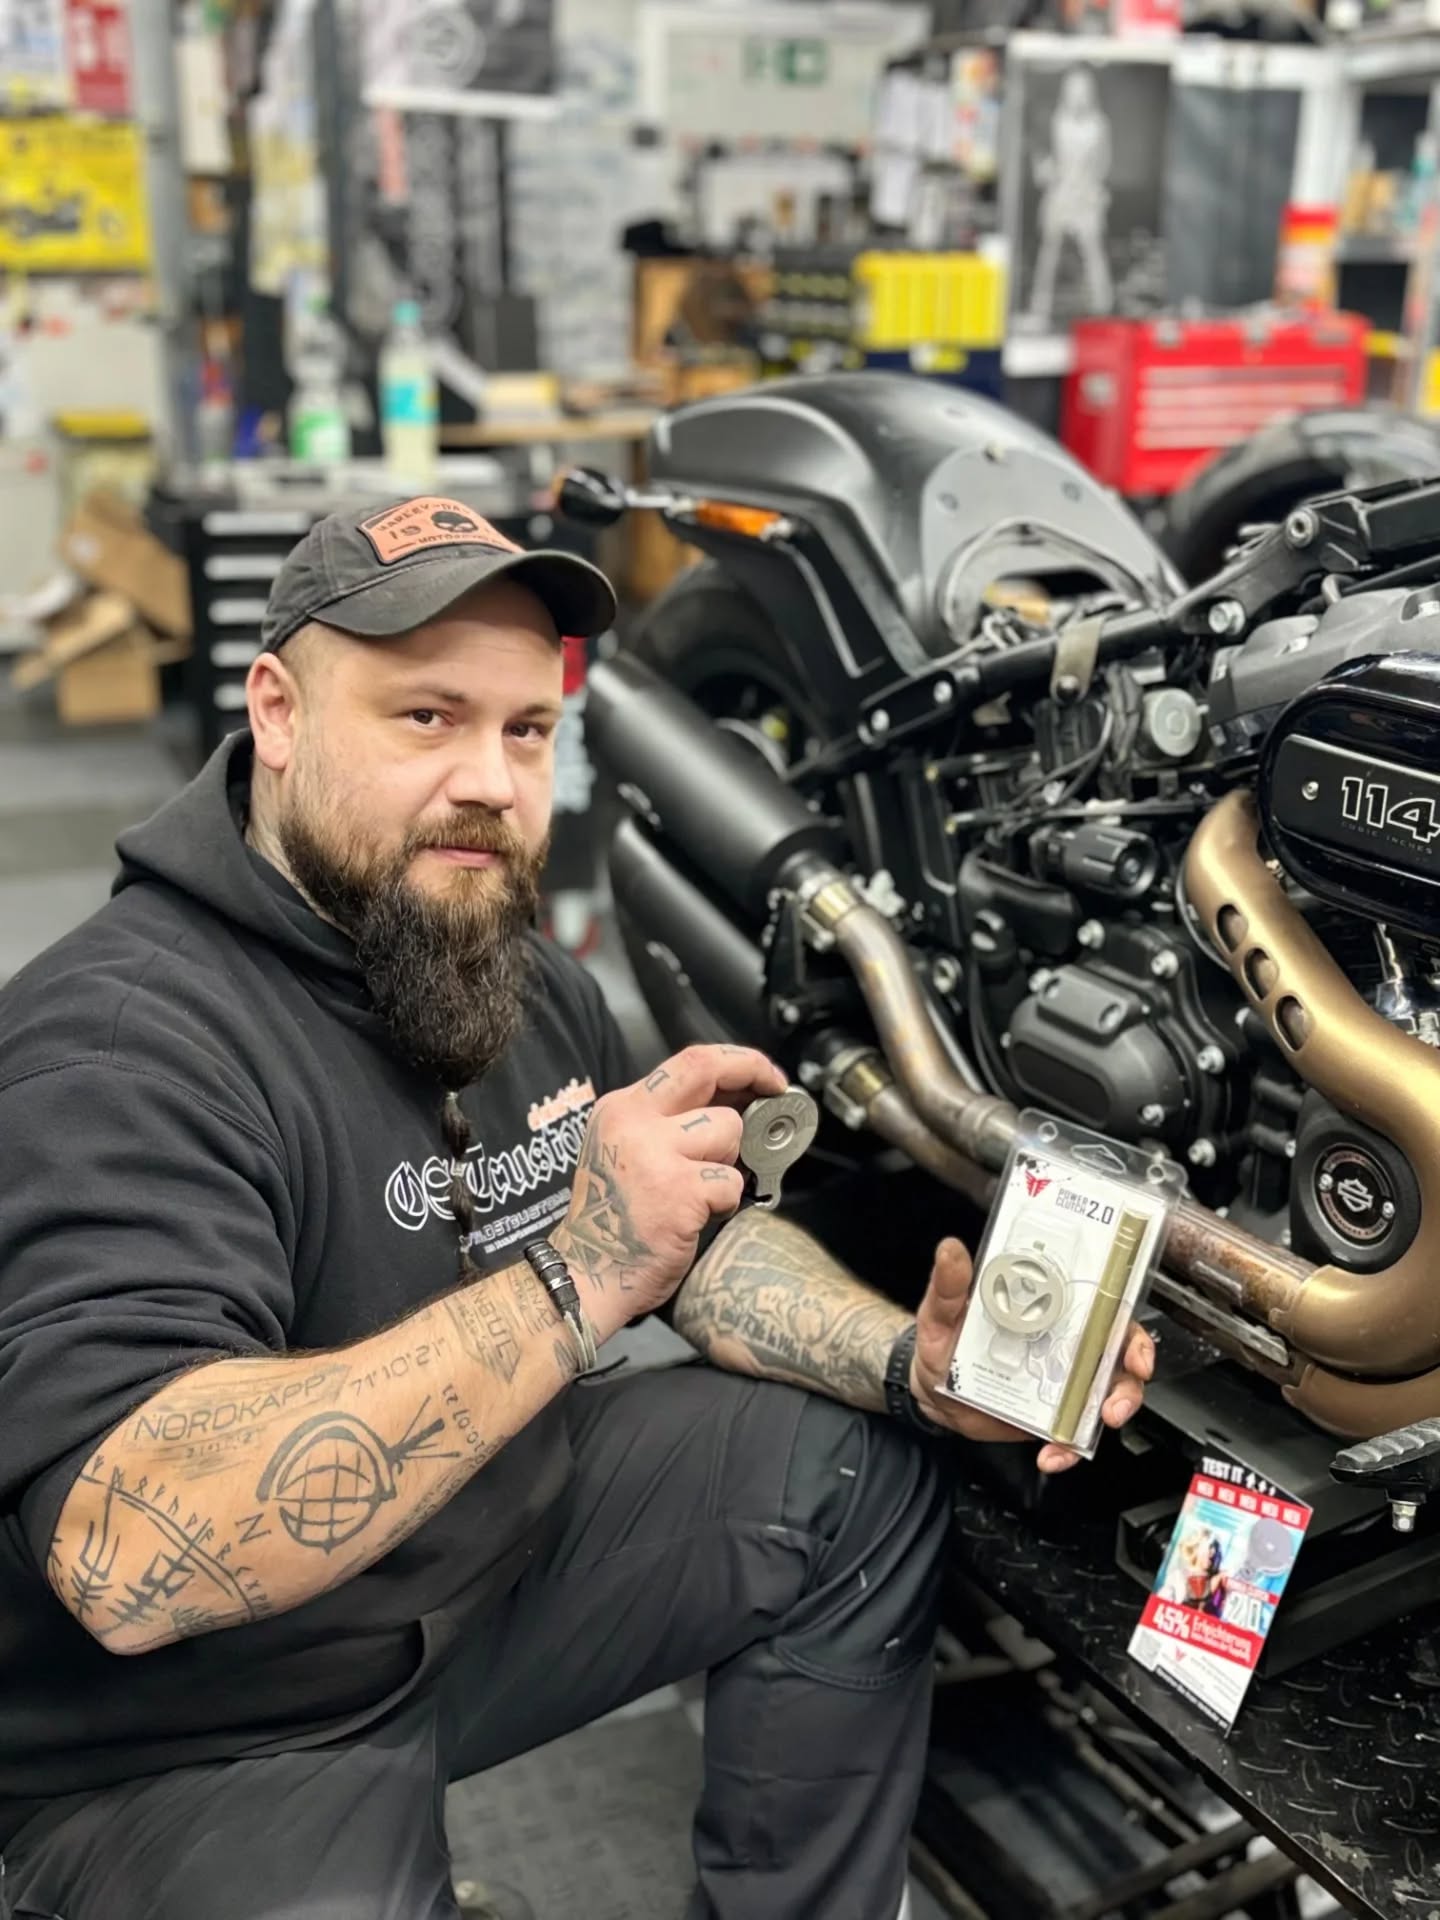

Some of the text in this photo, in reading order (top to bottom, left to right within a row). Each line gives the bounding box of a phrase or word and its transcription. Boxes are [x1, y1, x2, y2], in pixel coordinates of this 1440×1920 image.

[1341, 776, 1440, 843] 114
[1341, 820, 1432, 855] CUBIC INCHES
[1059, 1188, 1088, 1205] POWER
[1086, 1200, 1114, 1225] 2.0
[133, 1373, 327, 1442] NORDKAPP
[1202, 1456, 1246, 1485] TEST IT
[1152, 1603, 1191, 1640] 45%
